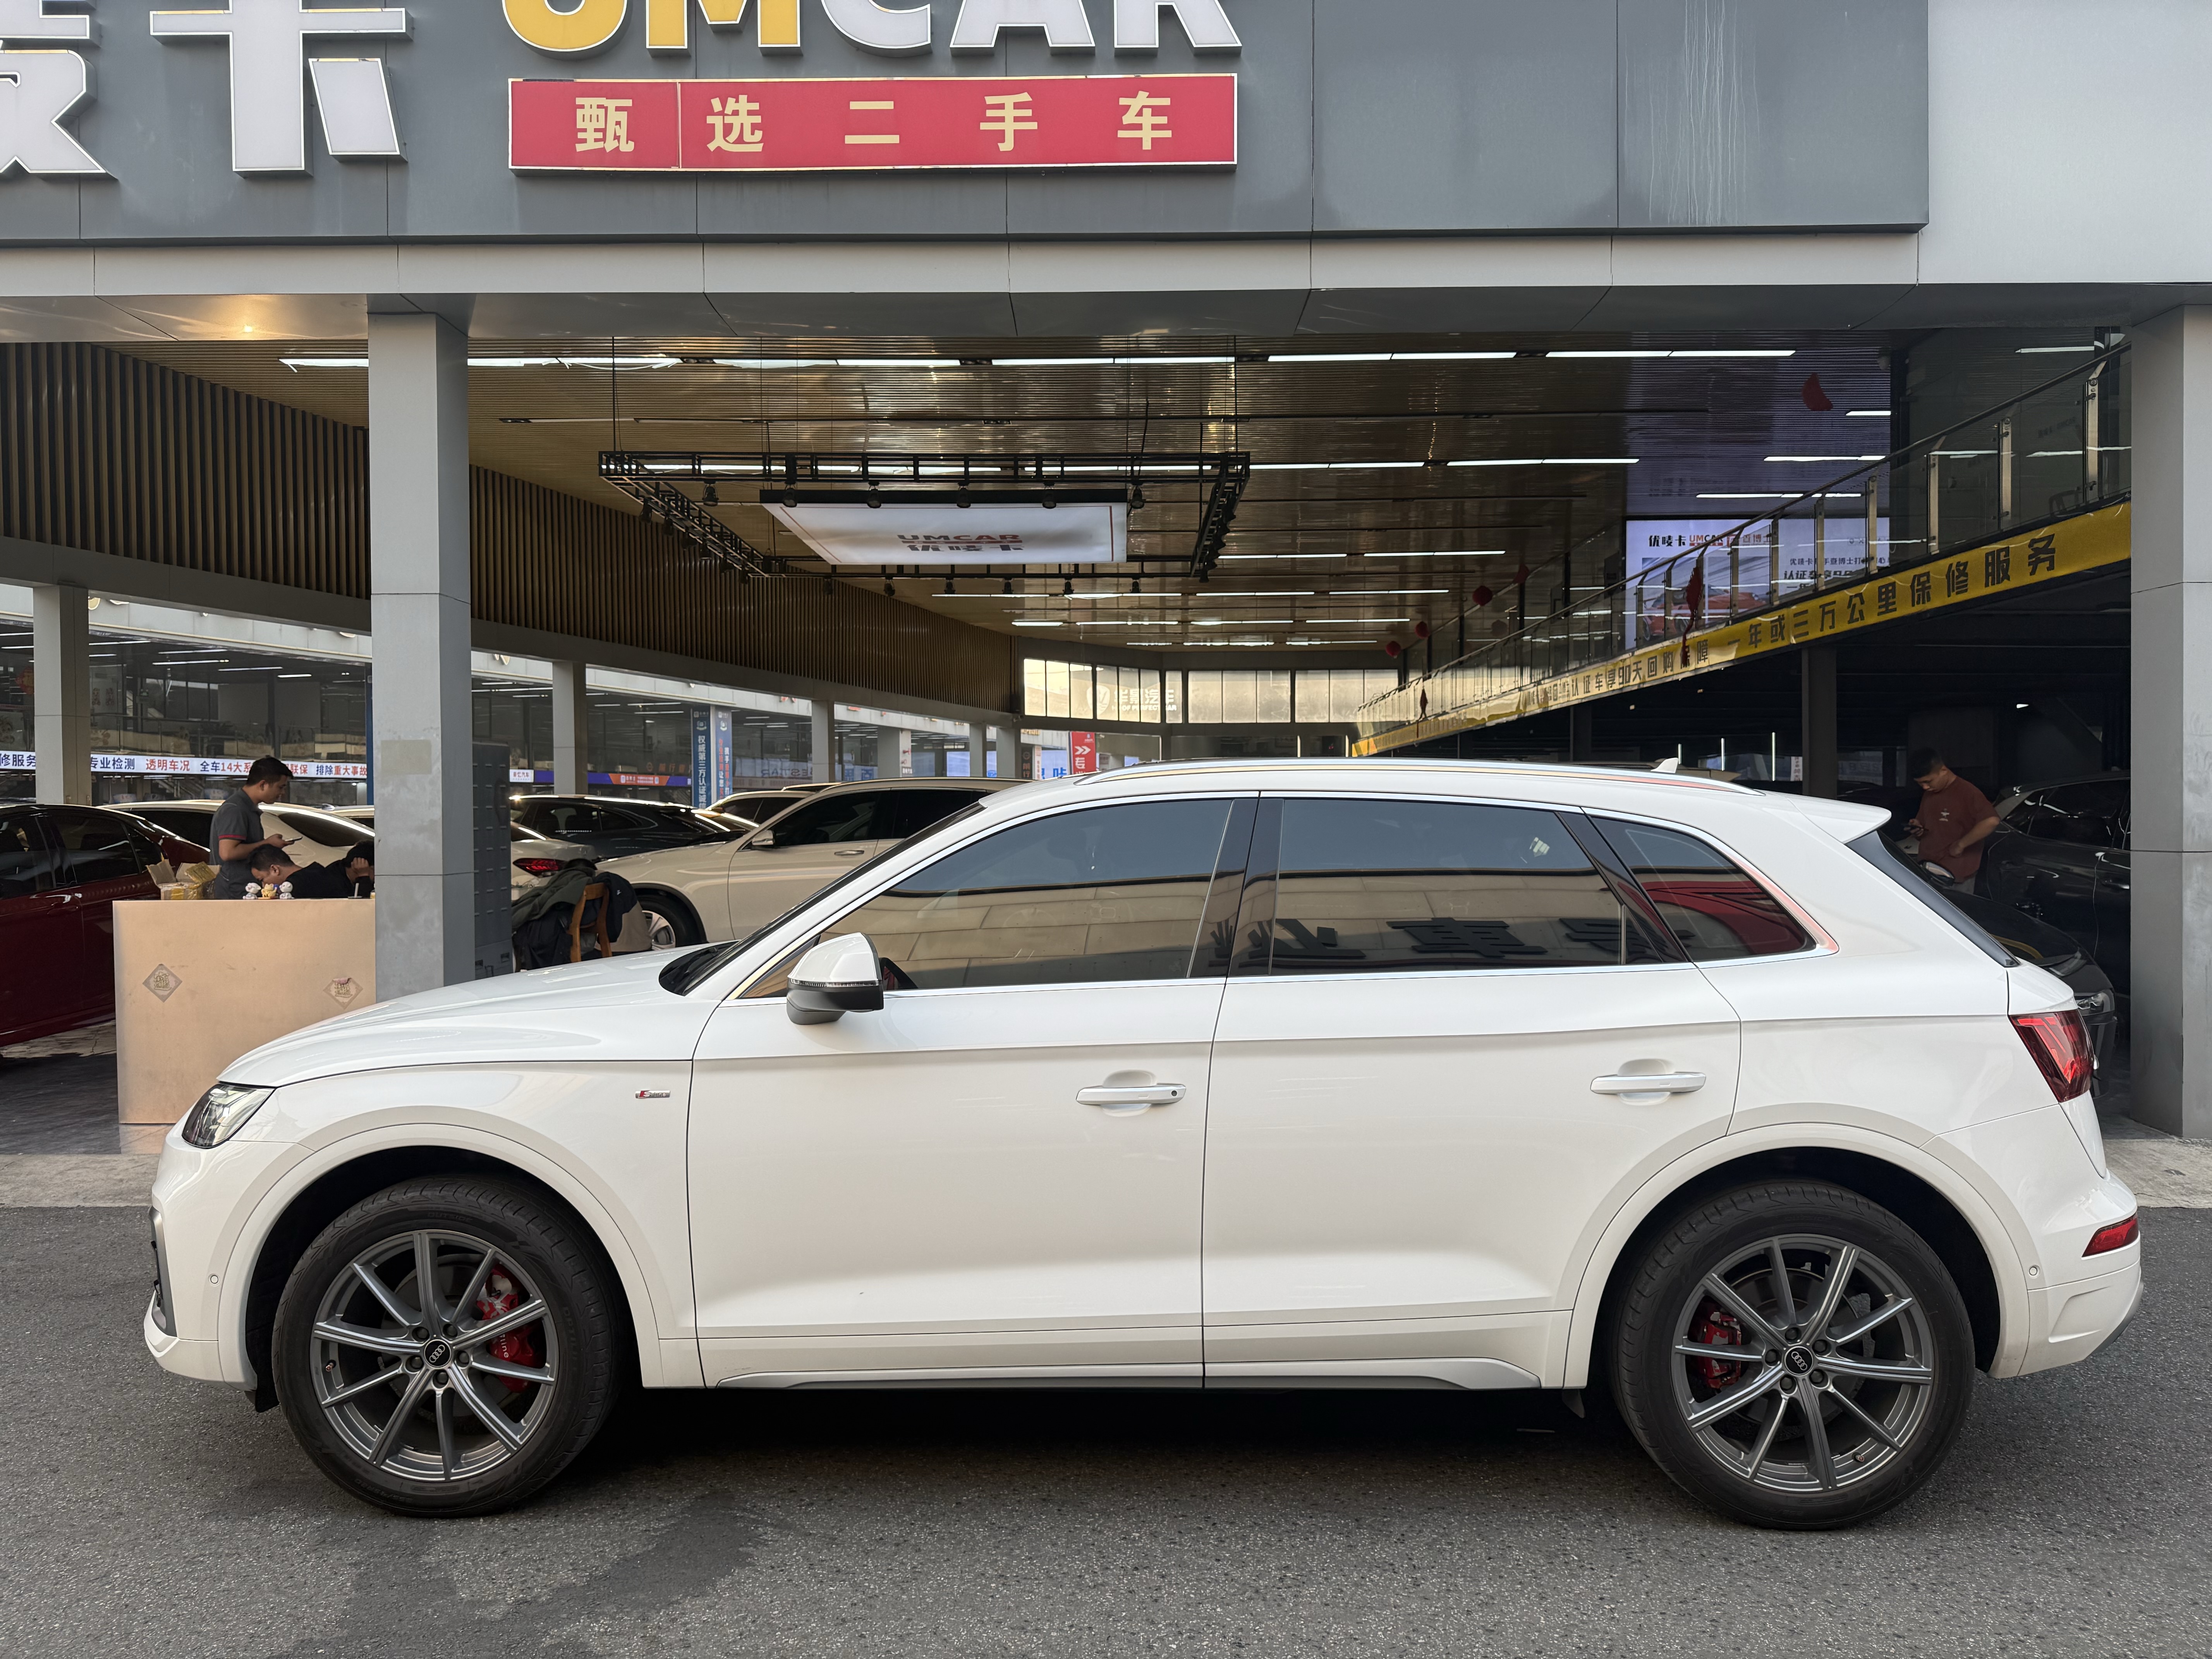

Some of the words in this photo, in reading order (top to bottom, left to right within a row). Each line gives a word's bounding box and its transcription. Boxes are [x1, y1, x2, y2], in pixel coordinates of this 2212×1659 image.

[576, 91, 1171, 151] 甄选二手车
[1649, 535, 1686, 547] 优唛卡
[1728, 533, 2056, 648] 一年或三万公里保修服务
[91, 756, 135, 770] 专业检测
[146, 758, 190, 772] 透明车况
[286, 764, 308, 775] 联保
[316, 764, 367, 776] 排除重大事故
